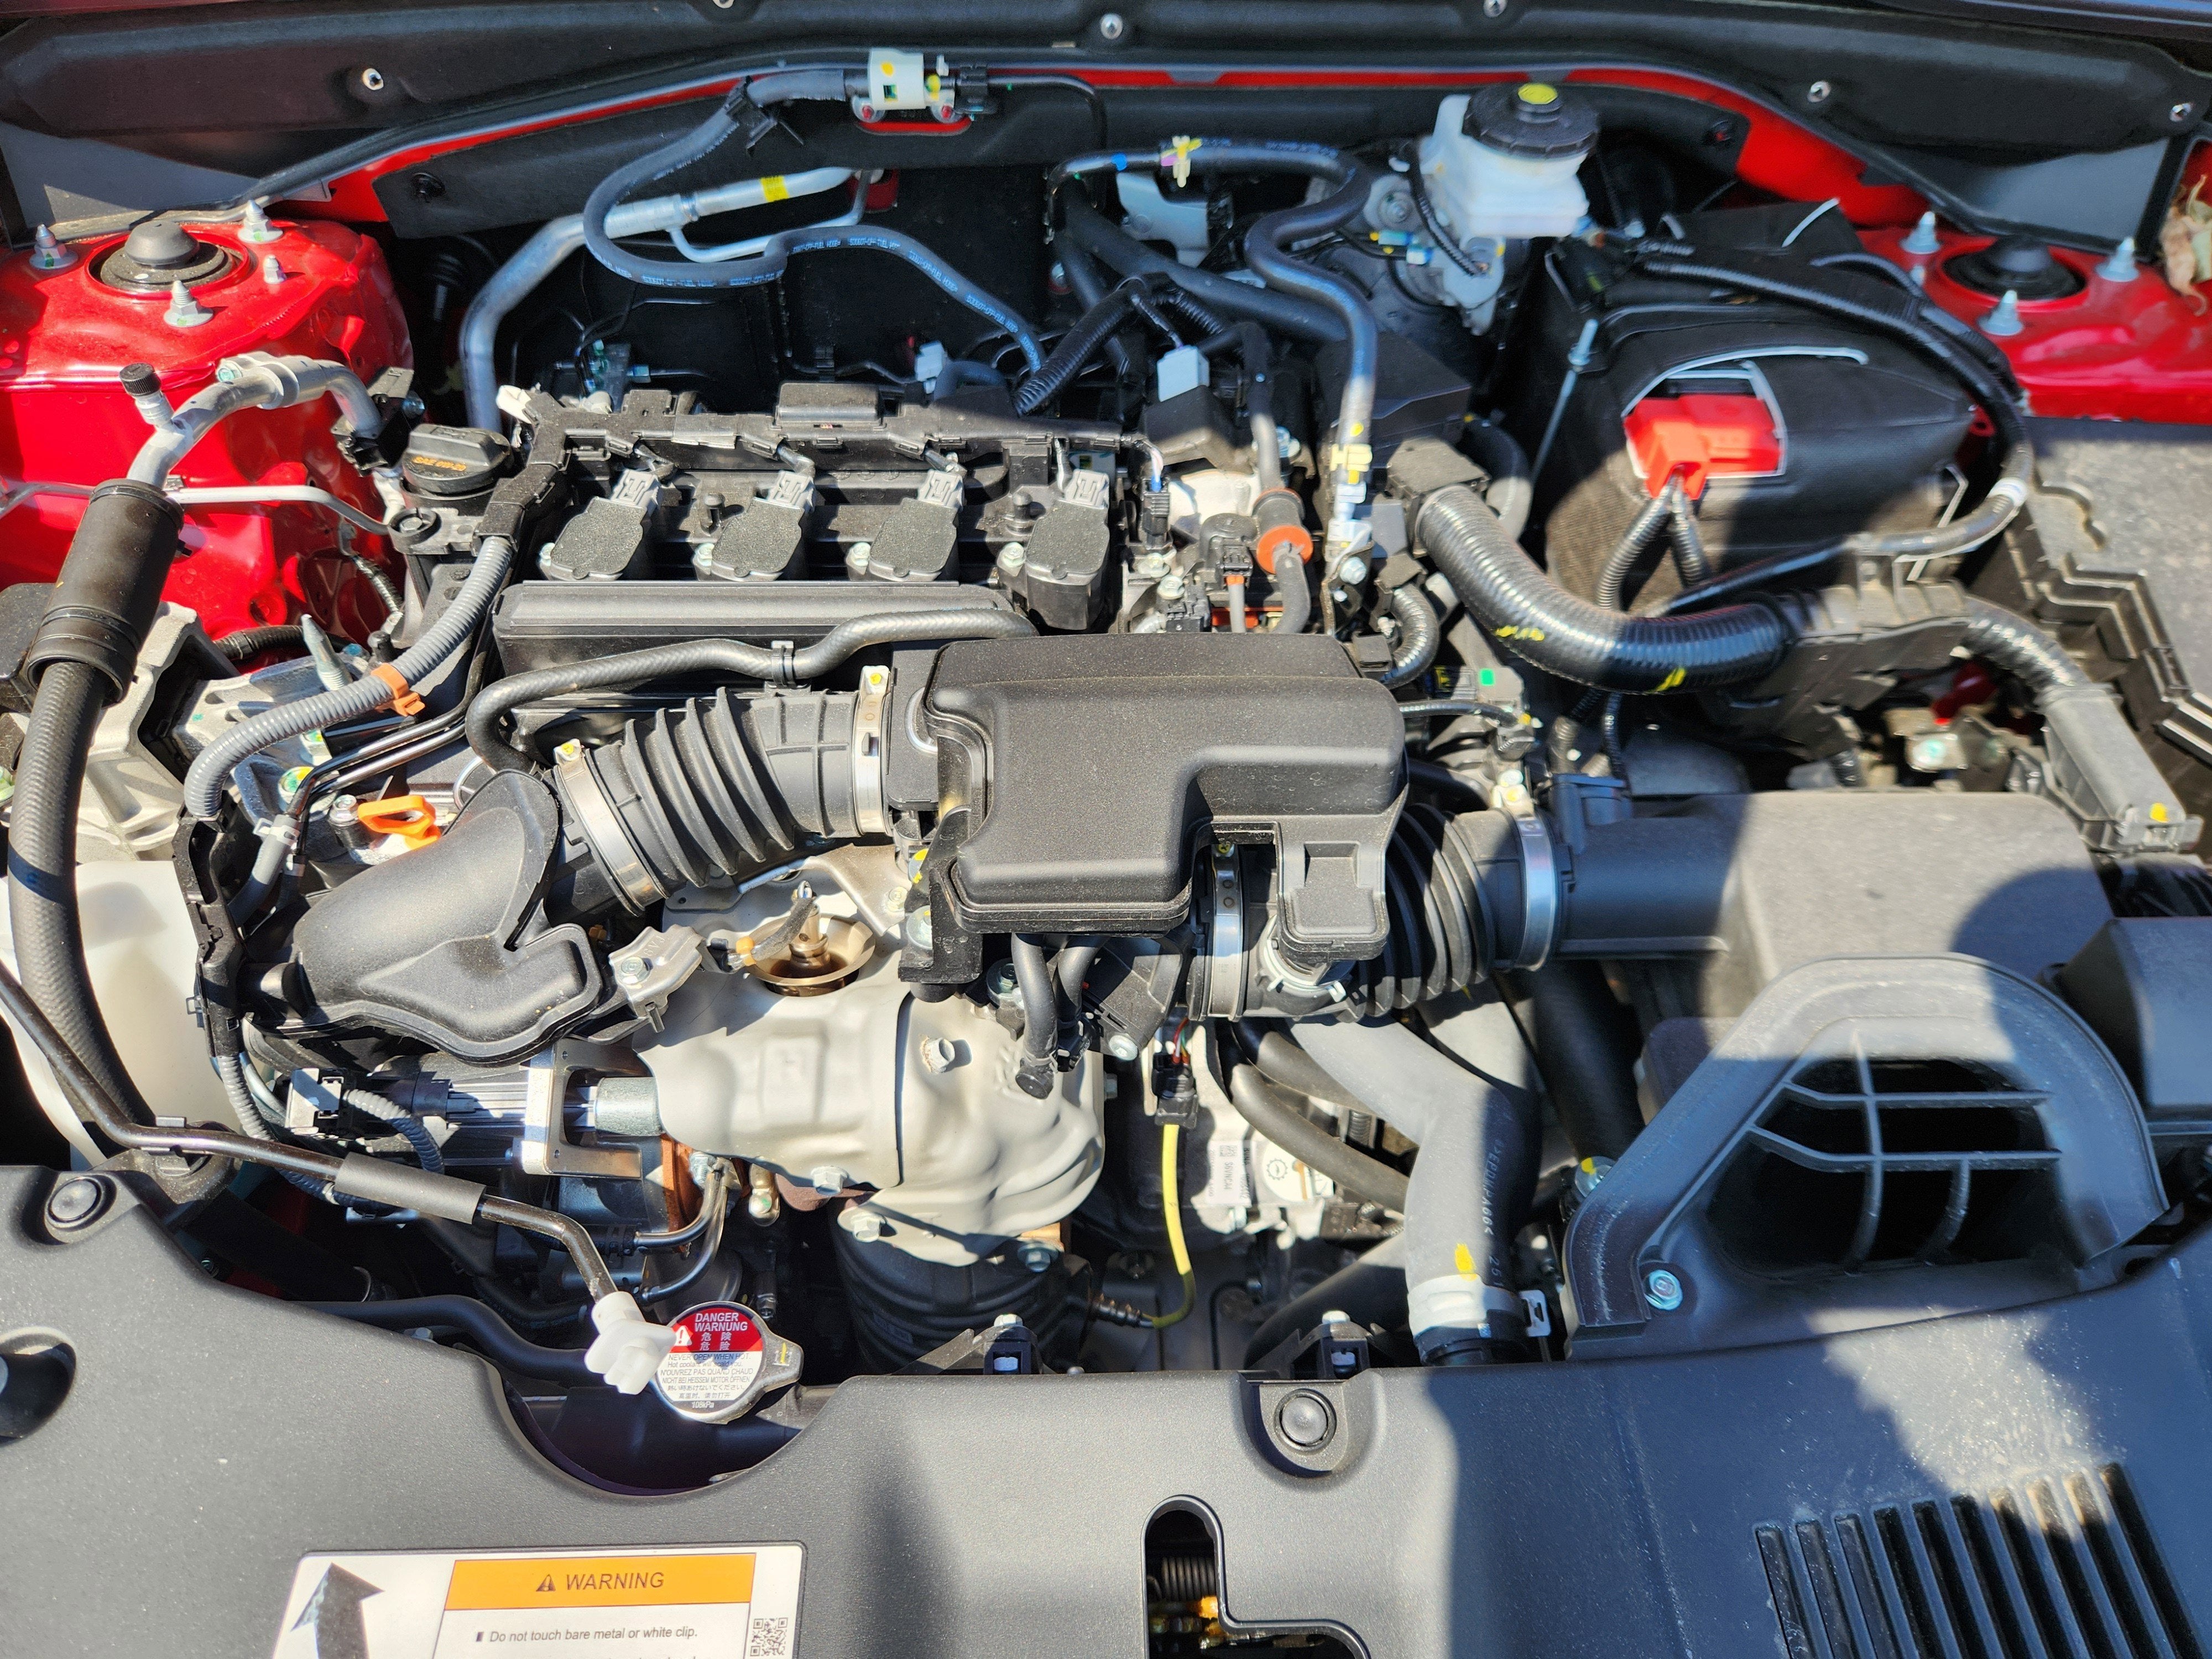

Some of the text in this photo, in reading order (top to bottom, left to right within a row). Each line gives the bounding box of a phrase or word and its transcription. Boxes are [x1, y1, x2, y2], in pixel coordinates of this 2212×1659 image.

[695, 1312, 739, 1322] DANGER
[695, 1322, 748, 1332] WARNUNG
[566, 1572, 665, 1590] WARNING
[489, 1626, 698, 1642] Do not touch bare metal or white clip.
